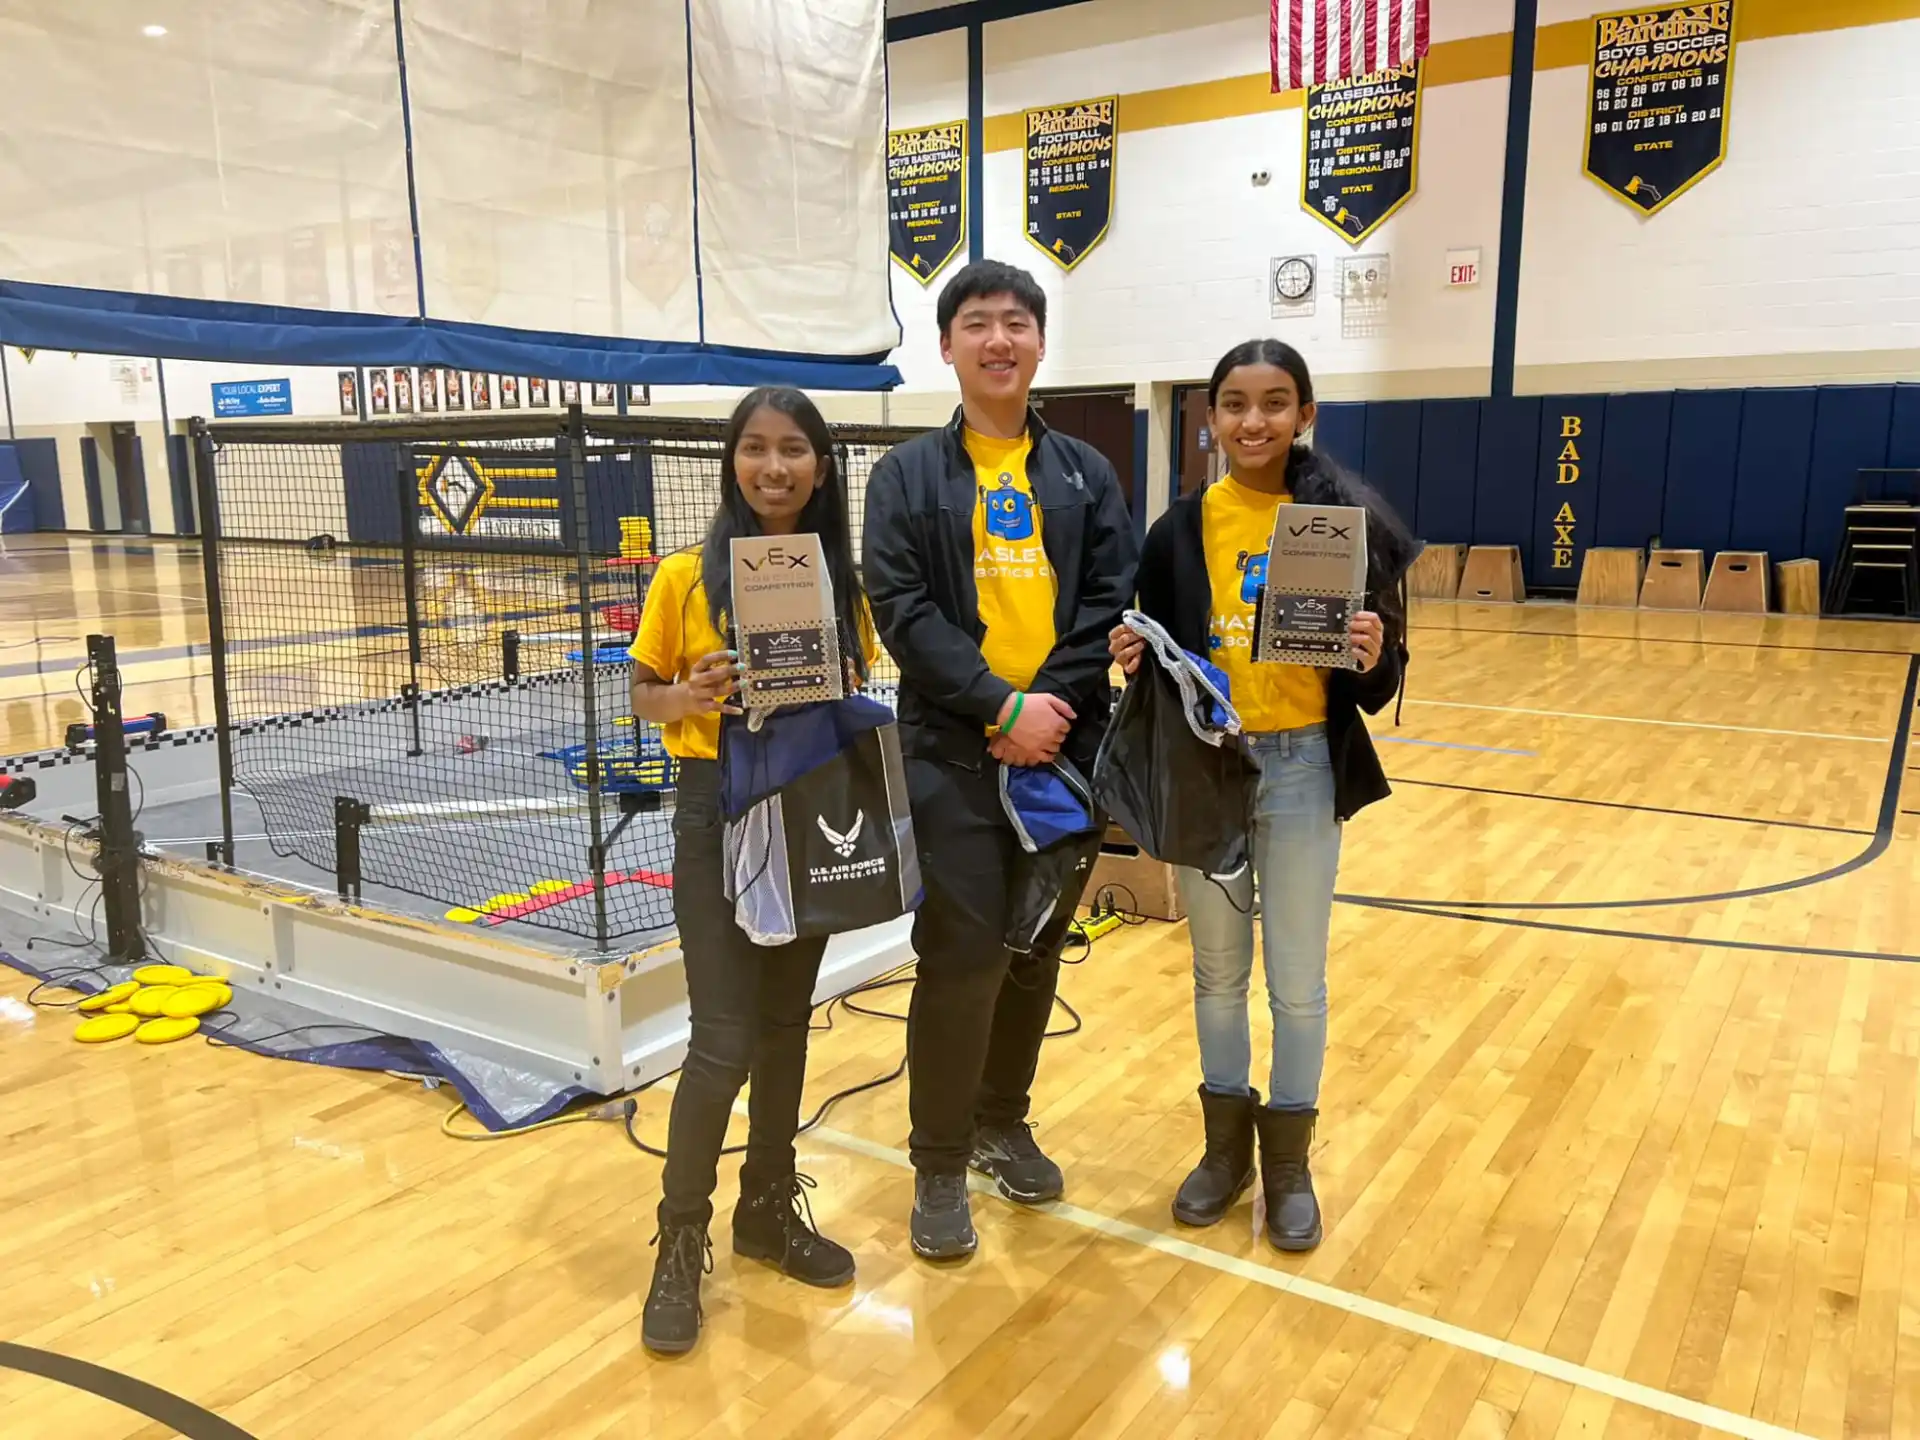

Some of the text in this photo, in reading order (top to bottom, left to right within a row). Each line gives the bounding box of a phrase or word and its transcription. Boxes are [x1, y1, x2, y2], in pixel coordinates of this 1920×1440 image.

[1598, 1, 1730, 49] BAD AXE
[1616, 21, 1710, 47] HATCHETS
[1598, 34, 1727, 61] BOYS SOCCER
[1595, 44, 1728, 78] CHAMPIONS
[1616, 68, 1703, 86] CONFERENCE
[1652, 81, 1666, 93] 07
[1690, 76, 1702, 88] 10
[1321, 82, 1402, 103] BASEBALL
[1308, 90, 1416, 120] CHAMPIONS
[1614, 98, 1627, 110] 20
[1628, 105, 1684, 119] DISTRICT
[1028, 101, 1112, 137] BAD AXE
[1326, 112, 1396, 128] CONFERENCE
[1612, 121, 1622, 132] 01
[1626, 119, 1640, 130] 07
[1644, 117, 1654, 128] 12
[1692, 110, 1706, 122] 20
[1709, 107, 1721, 119] 21
[1038, 128, 1101, 145] FOOTBALL
[1028, 135, 1112, 160] CHAMPIONS
[1336, 143, 1382, 156] DISTRICT
[1634, 140, 1674, 152] STATE
[889, 149, 960, 168] BOYS BASKETBALL
[1042, 153, 1097, 166] CONFERENCE
[888, 158, 961, 180] CHAMPIONS
[1332, 166, 1383, 177] REGIONAL
[1048, 182, 1090, 193] REGIONAL
[1341, 184, 1374, 194] STATE
[1056, 210, 1082, 220] STATE
[914, 234, 936, 242] STATE
[1450, 264, 1474, 283] EXIT
[1552, 416, 1582, 568] BAD AXE
[1288, 517, 1350, 540] VEX
[742, 548, 810, 571] VEX
[1282, 549, 1350, 560] COMPETITION
[976, 566, 1034, 578] BOTICS
[744, 582, 814, 592] COMPETITION
[1296, 598, 1327, 610] VEX
[768, 633, 802, 646] VEX
[830, 864, 850, 874] AIR
[851, 856, 885, 871] FORCE
[810, 865, 886, 884] AIRFORCE.COM
